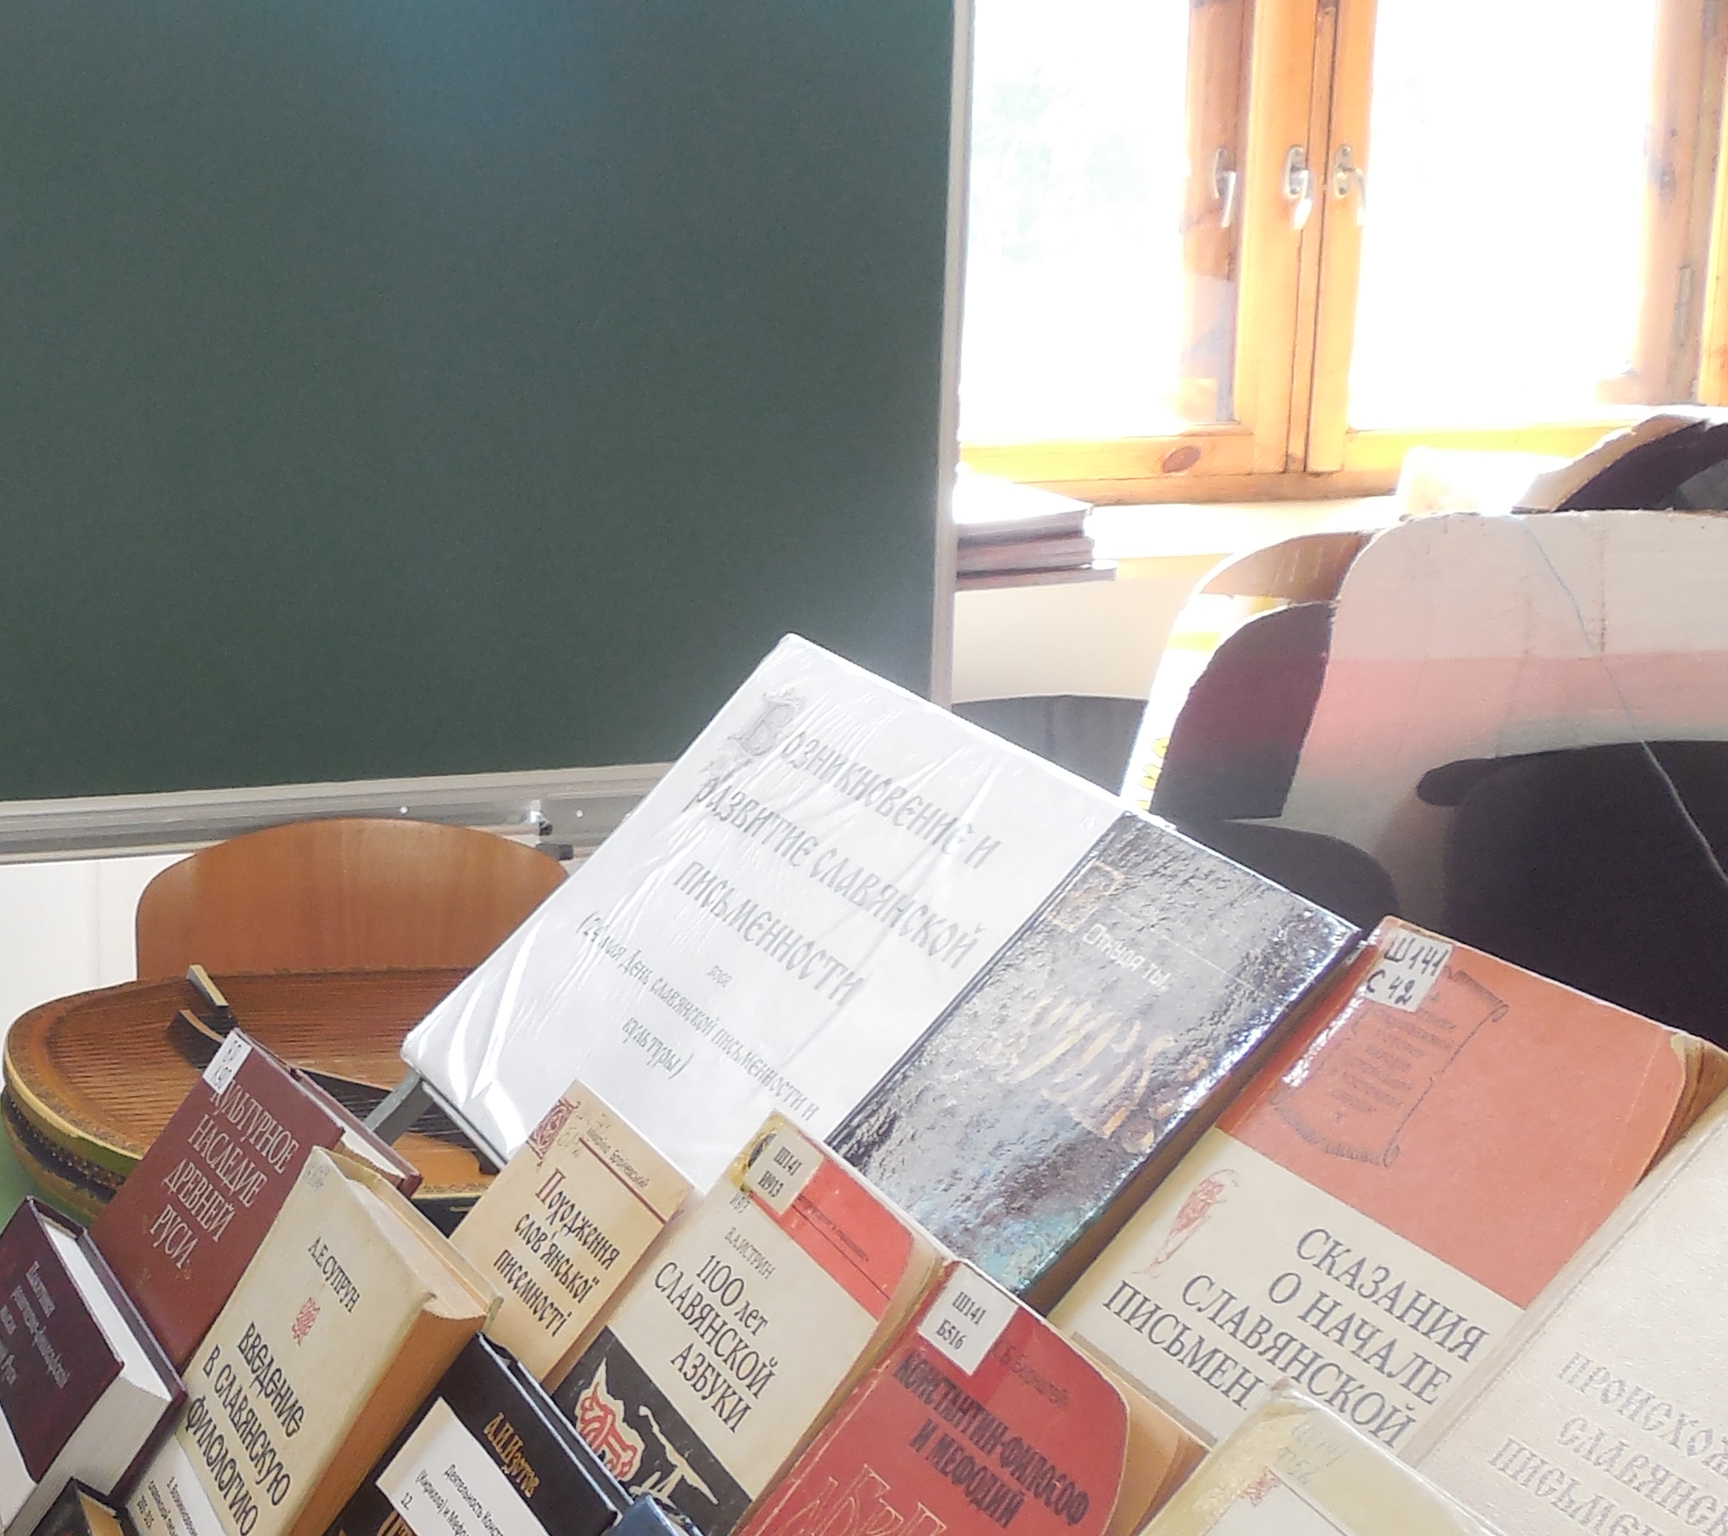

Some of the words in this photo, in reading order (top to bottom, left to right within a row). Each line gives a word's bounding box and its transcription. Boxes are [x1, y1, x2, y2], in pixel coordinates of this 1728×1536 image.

[681, 779, 824, 868] развитие
[805, 849, 990, 970] славянской
[961, 835, 1002, 871] и
[671, 859, 868, 1007] письменности
[1380, 937, 1452, 976] Ш141
[1361, 968, 1389, 992] С
[709, 1026, 809, 1111] письменности
[186, 1113, 269, 1209] НАСЛЕДИЕ
[208, 1074, 301, 1175] КУЛЬТУРНОЕ
[772, 1145, 802, 1177] Ш141
[161, 1155, 239, 1243] ДРЕВНЕЙ
[534, 1165, 620, 1271] Походження
[757, 1170, 784, 1199] И913
[148, 1203, 200, 1270] РУСИ
[723, 1225, 776, 1280] В.А.ИСТРИН
[492, 1247, 572, 1338] писемності
[651, 1259, 779, 1399] СЛАВЯНСКОЙ
[695, 1252, 749, 1309] 1100
[732, 1298, 769, 1338] лет
[934, 1319, 968, 1351] Б516
[949, 1290, 988, 1326] Ш141
[1261, 1268, 1307, 1308] О
[1296, 1290, 1456, 1406] НАЧАЛЕ
[1290, 1224, 1493, 1363] СКАЗАНИЯ
[235, 1319, 308, 1441] ВВЕДЕНИЕ
[669, 1338, 752, 1434] АЗБУКИ
[1175, 1271, 1424, 1449] СЛАВЯНСКОЙ
[213, 1361, 294, 1511] СЛАВЯНСКУЮ
[907, 1417, 939, 1453] И
[925, 1433, 1029, 1529] МЕФОДИЙ
[413, 1468, 449, 1514] (Кирилла)
[442, 1462, 488, 1520] Деятельность
